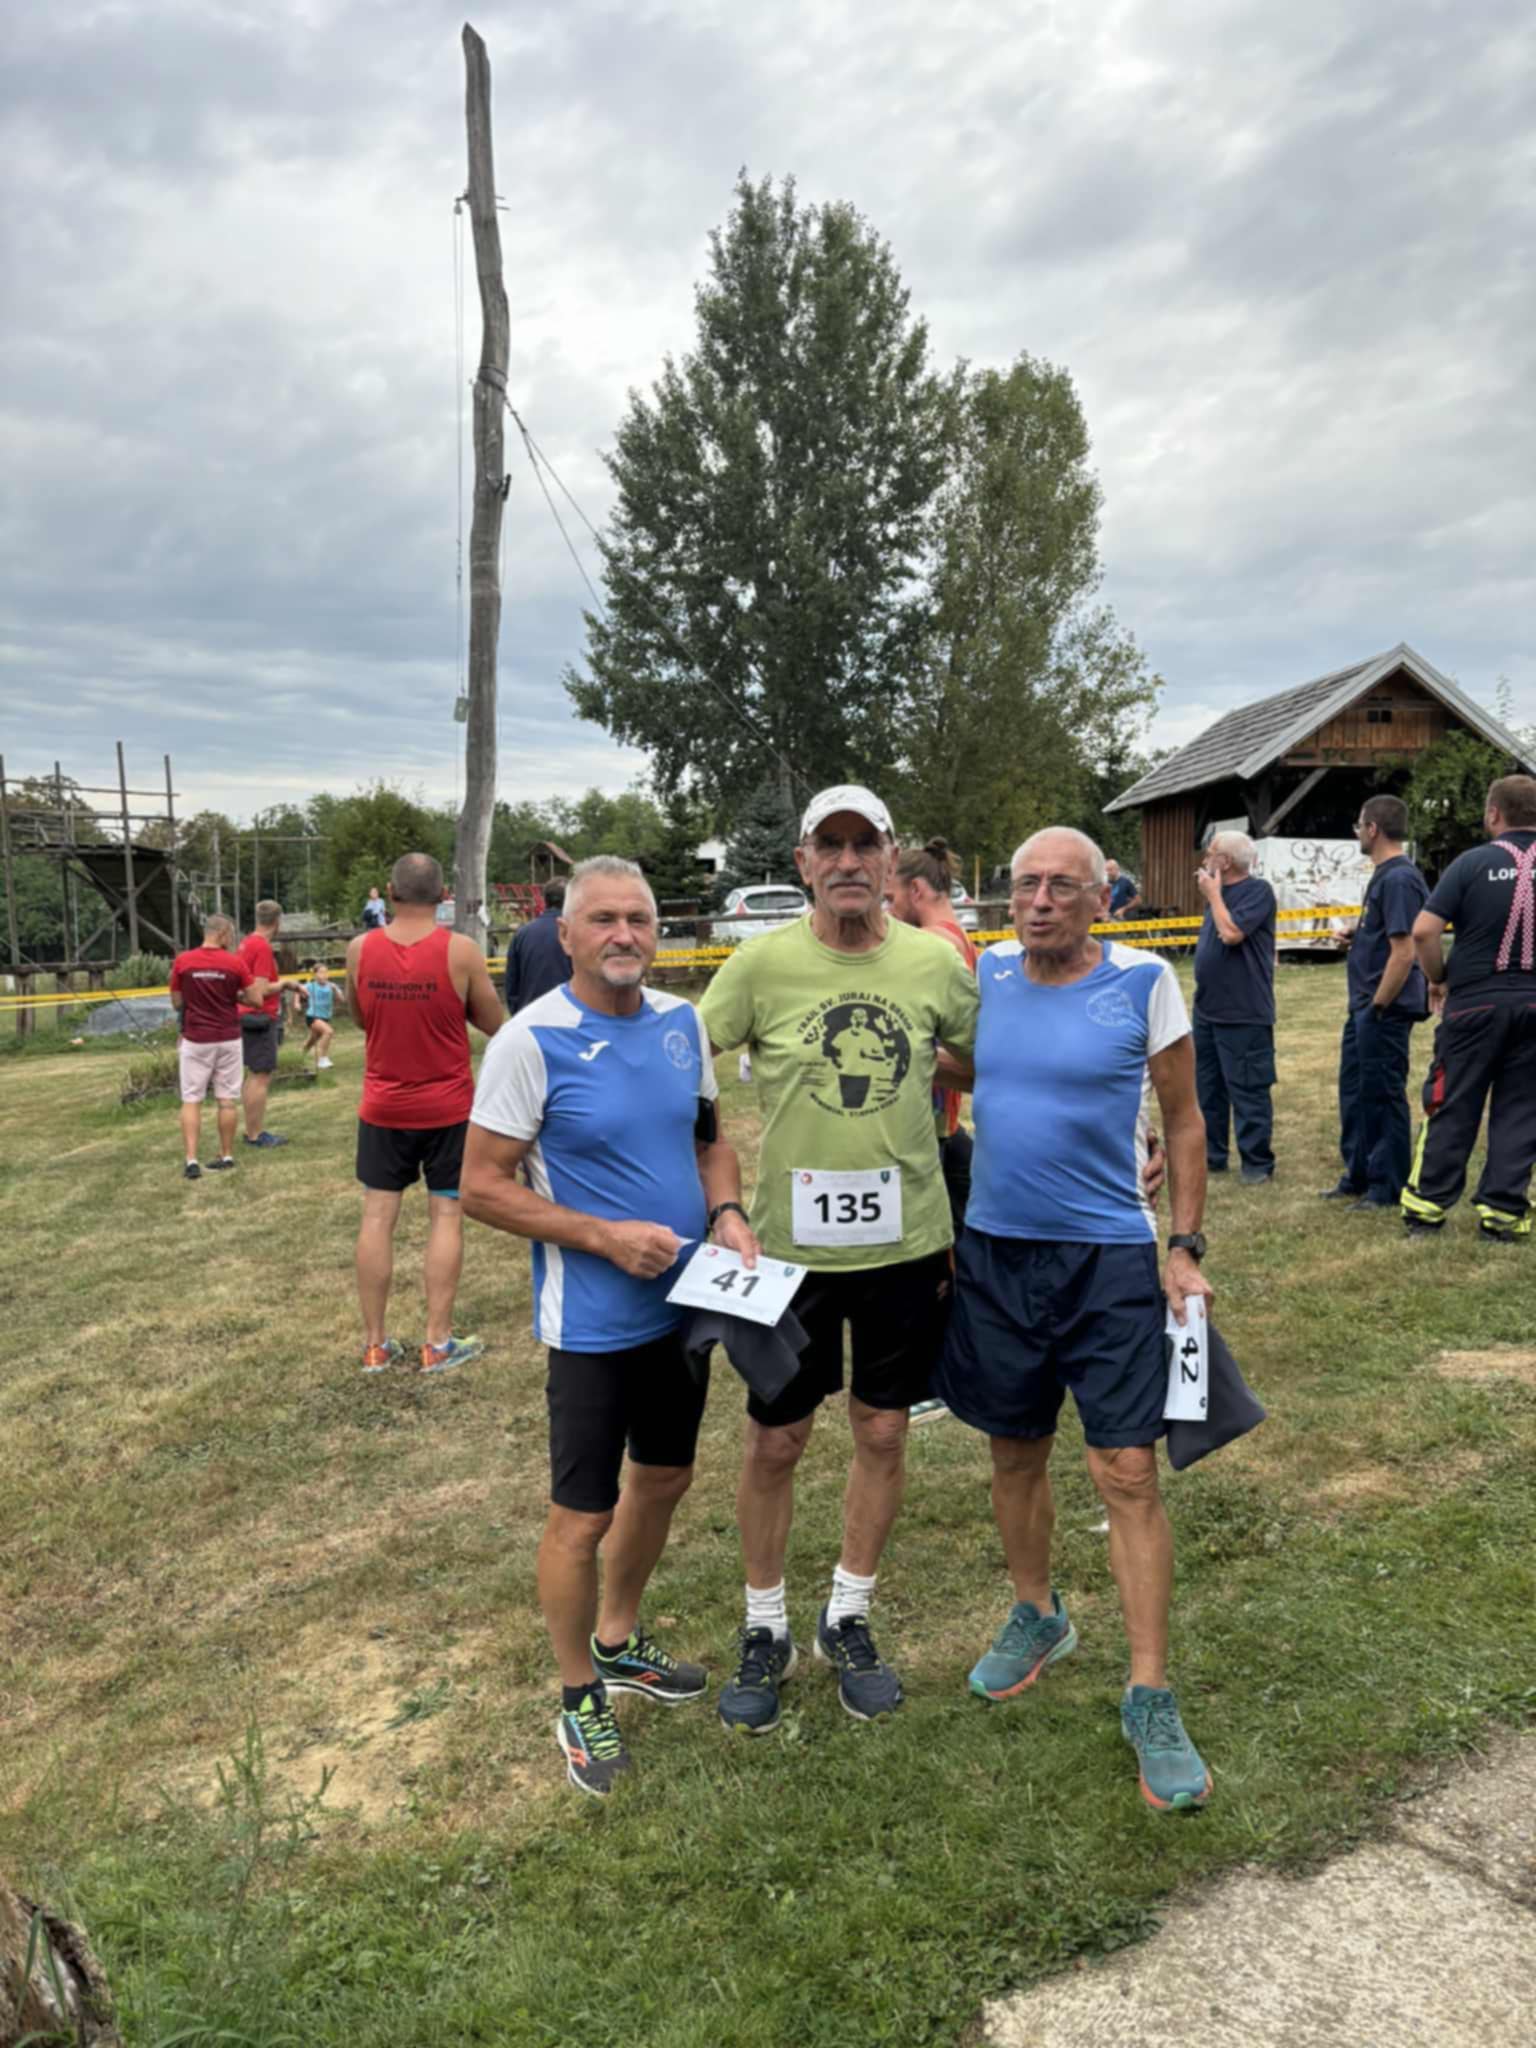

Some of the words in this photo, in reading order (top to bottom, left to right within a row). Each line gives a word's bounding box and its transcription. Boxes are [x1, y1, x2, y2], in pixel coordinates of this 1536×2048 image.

[873, 993, 888, 1006] NA
[813, 1192, 882, 1223] 135
[711, 1269, 760, 1298] 41
[1180, 1336, 1199, 1385] 42
